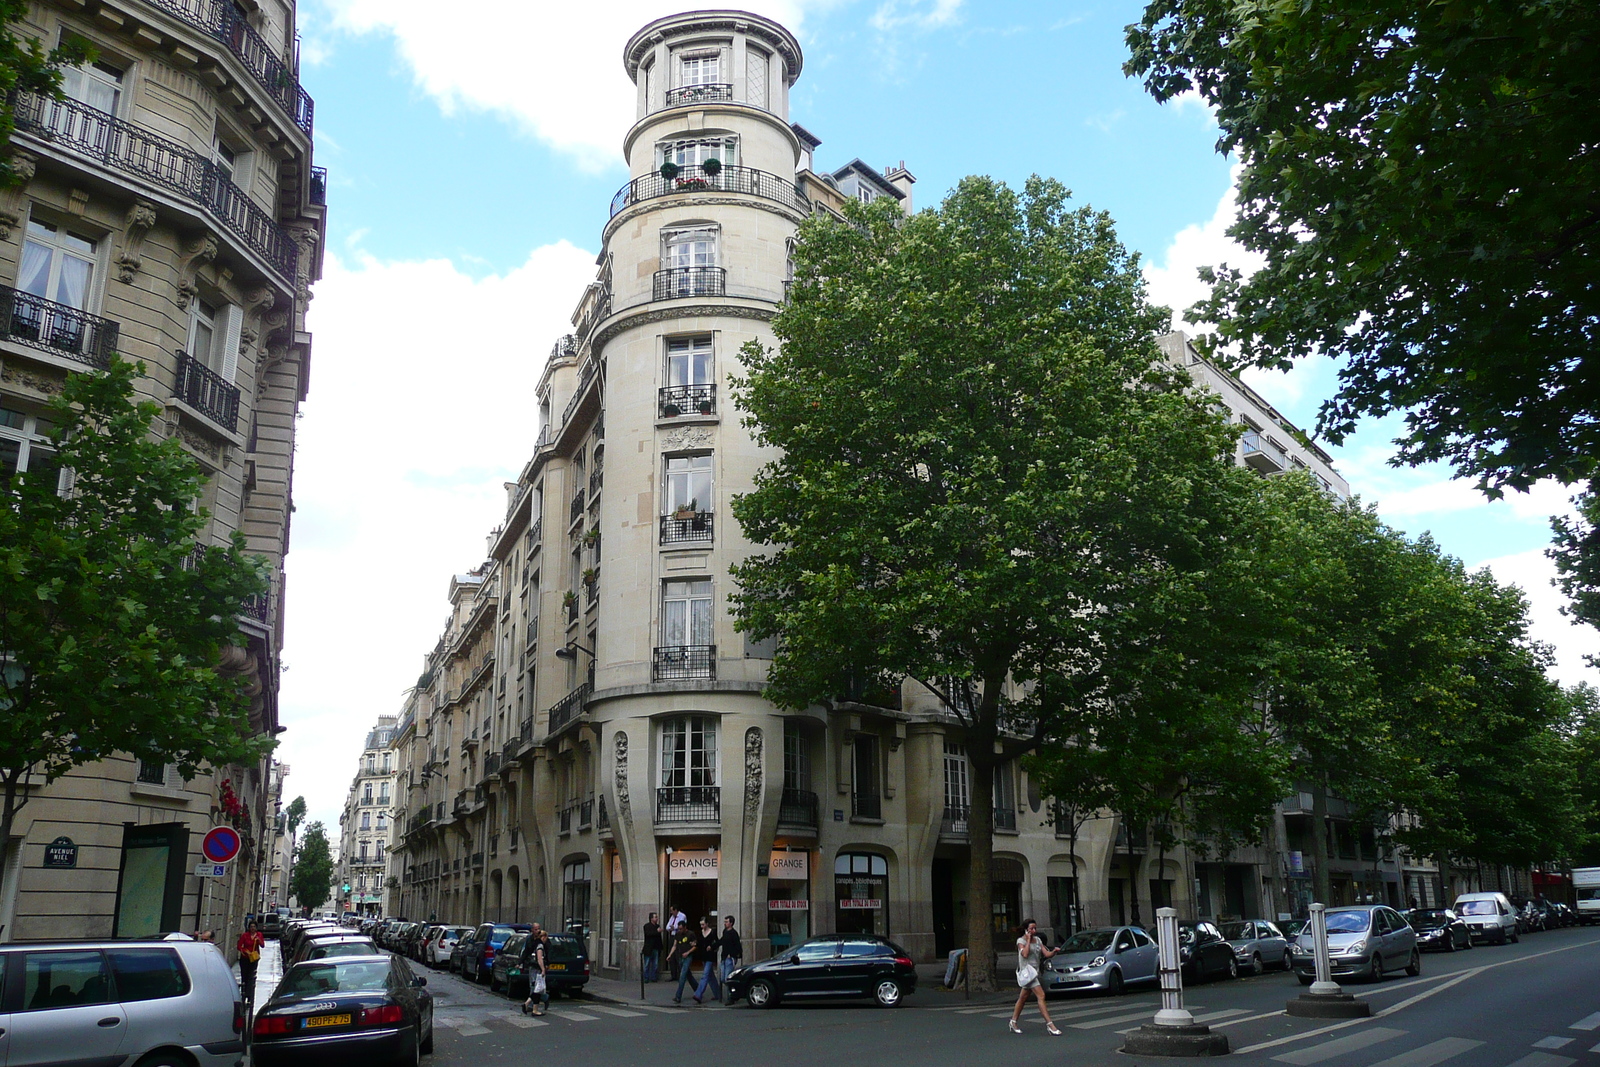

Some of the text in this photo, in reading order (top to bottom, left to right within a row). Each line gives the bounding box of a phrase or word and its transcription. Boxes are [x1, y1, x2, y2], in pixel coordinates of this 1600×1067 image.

[670, 858, 718, 868] GRANGE
[772, 858, 803, 868] GRANGE
[339, 1014, 349, 1023] 75
